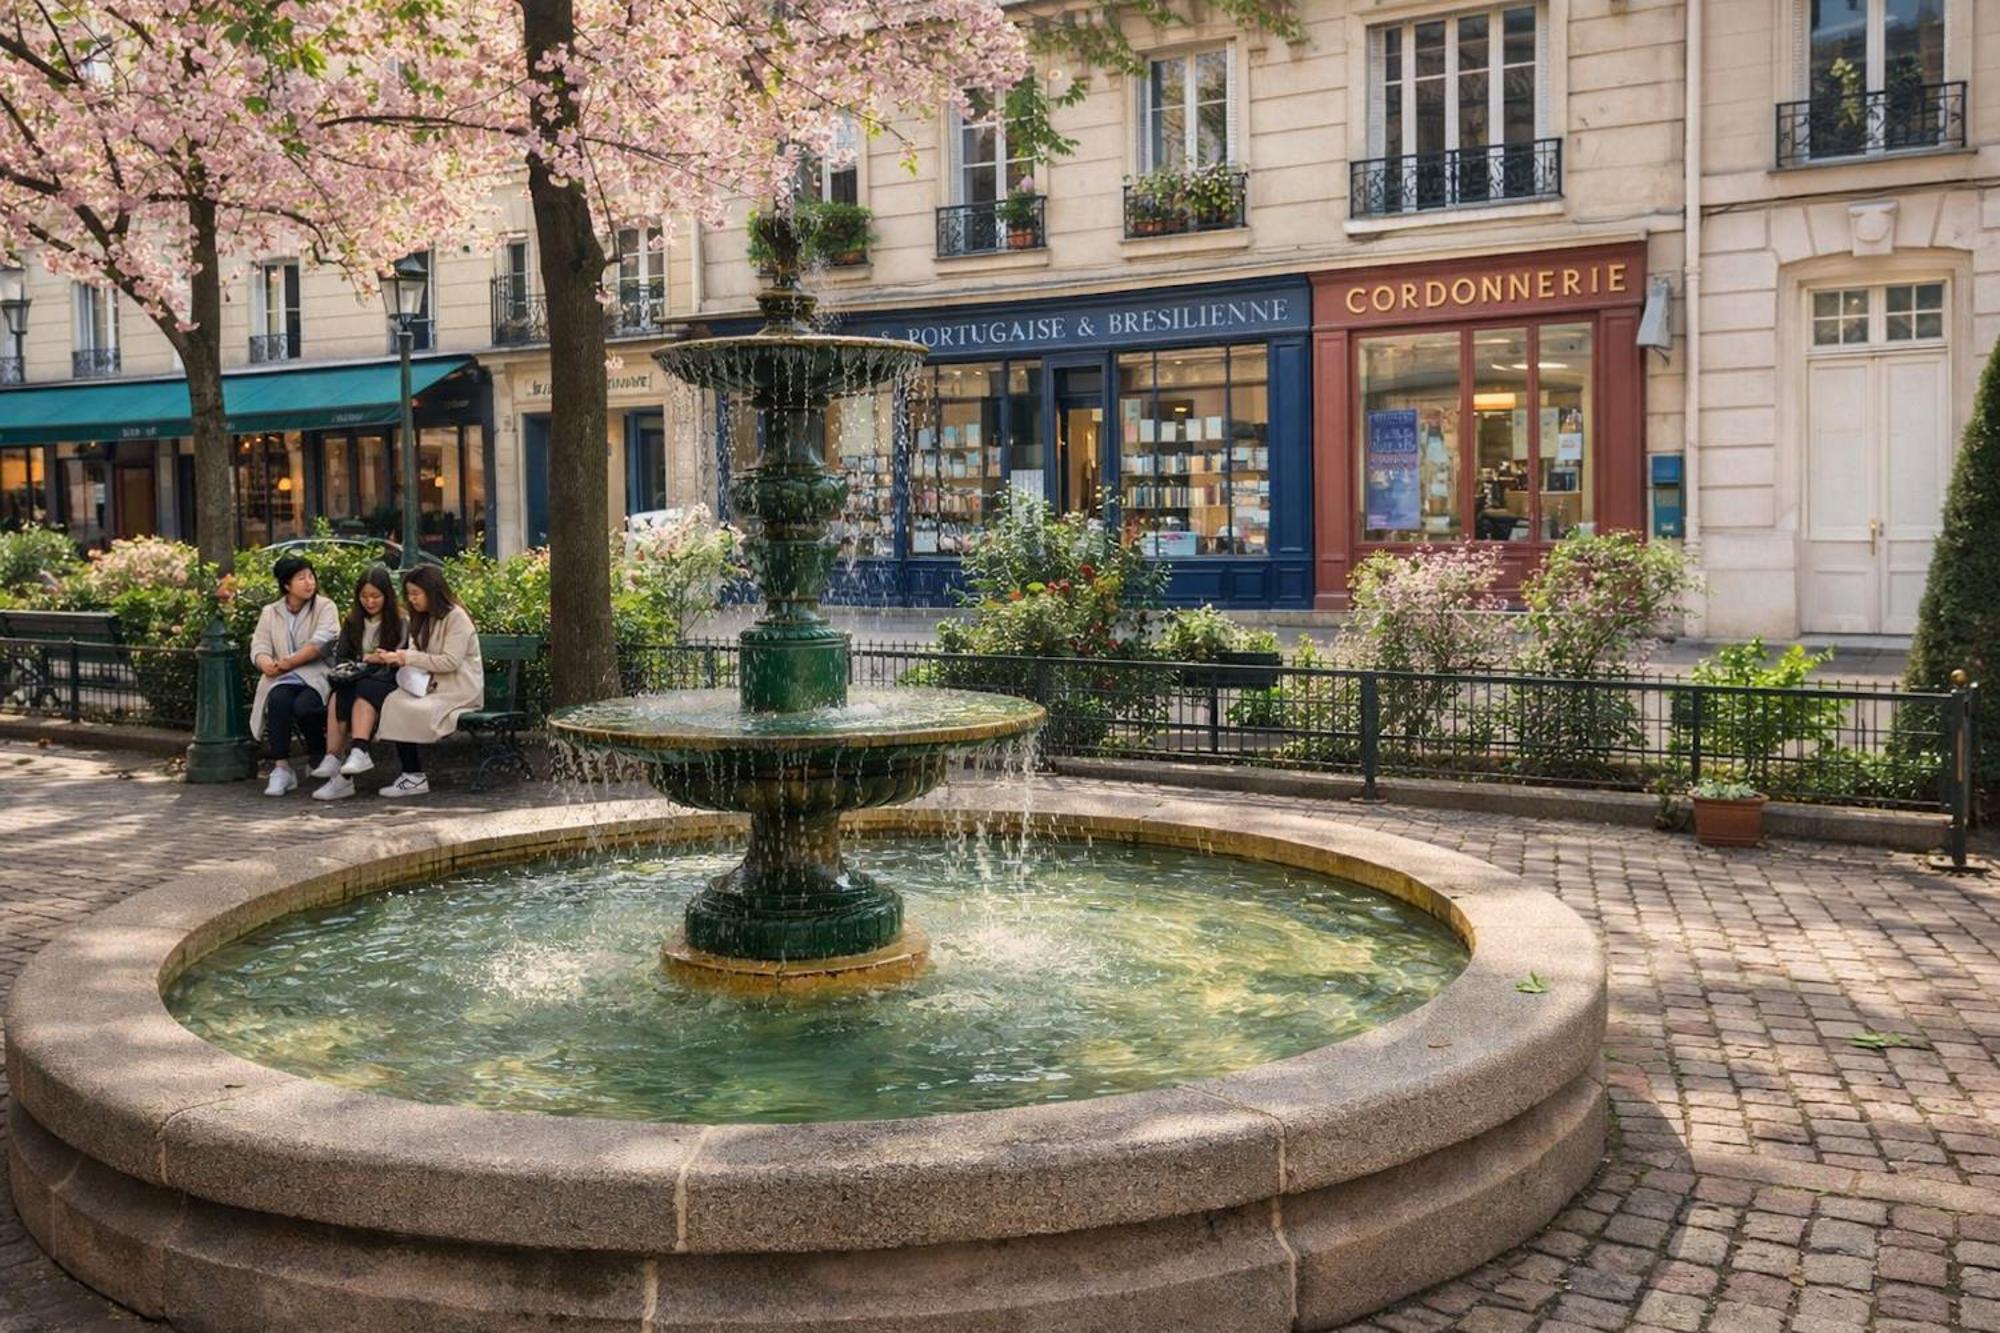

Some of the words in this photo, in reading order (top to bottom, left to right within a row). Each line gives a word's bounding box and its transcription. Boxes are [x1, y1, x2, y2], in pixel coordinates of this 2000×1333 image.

[1346, 264, 1627, 314] CORDONNERIE
[907, 317, 1066, 348] PORTUGAISE
[1077, 316, 1097, 337] &
[1109, 298, 1288, 335] BRESILIENNE
